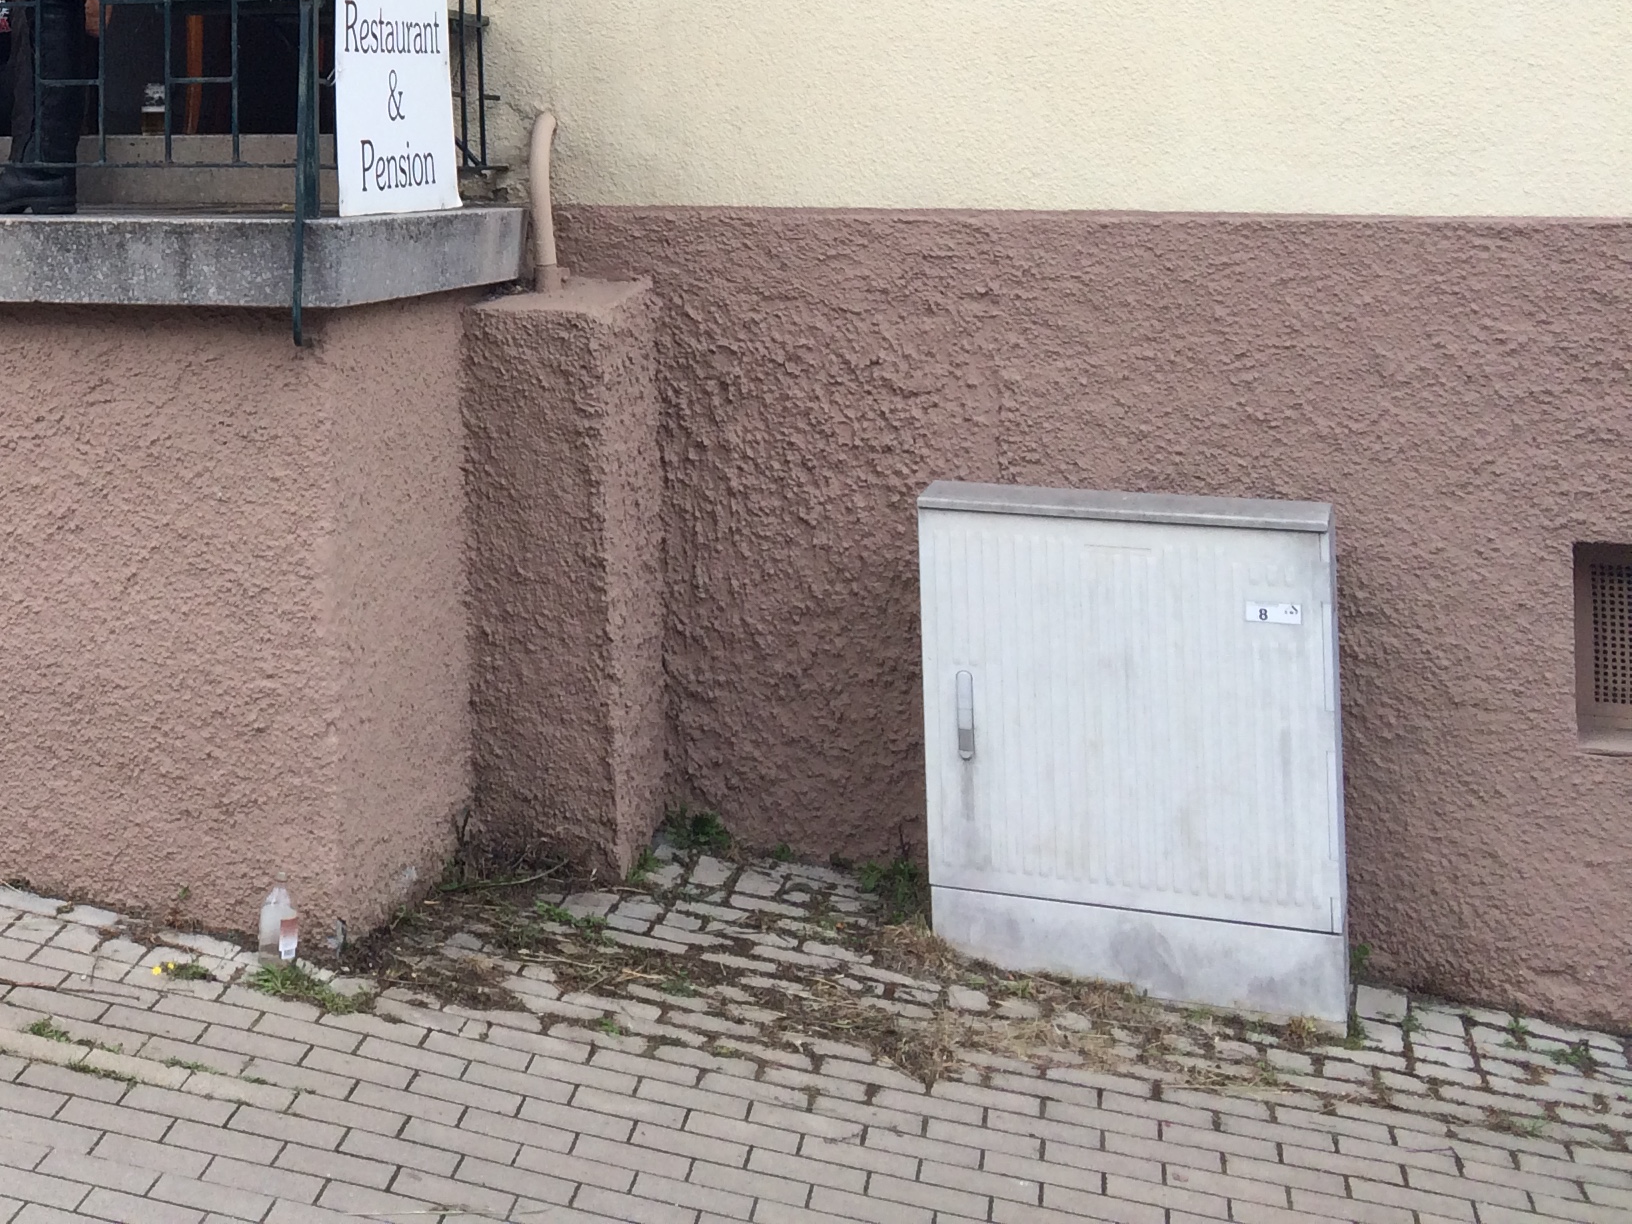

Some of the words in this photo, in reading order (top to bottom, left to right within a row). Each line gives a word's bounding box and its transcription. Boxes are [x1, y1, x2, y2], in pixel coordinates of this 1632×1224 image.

[344, 0, 441, 55] Restaurant
[387, 68, 405, 122] &
[360, 139, 437, 192] Pension
[1258, 608, 1268, 621] 8
